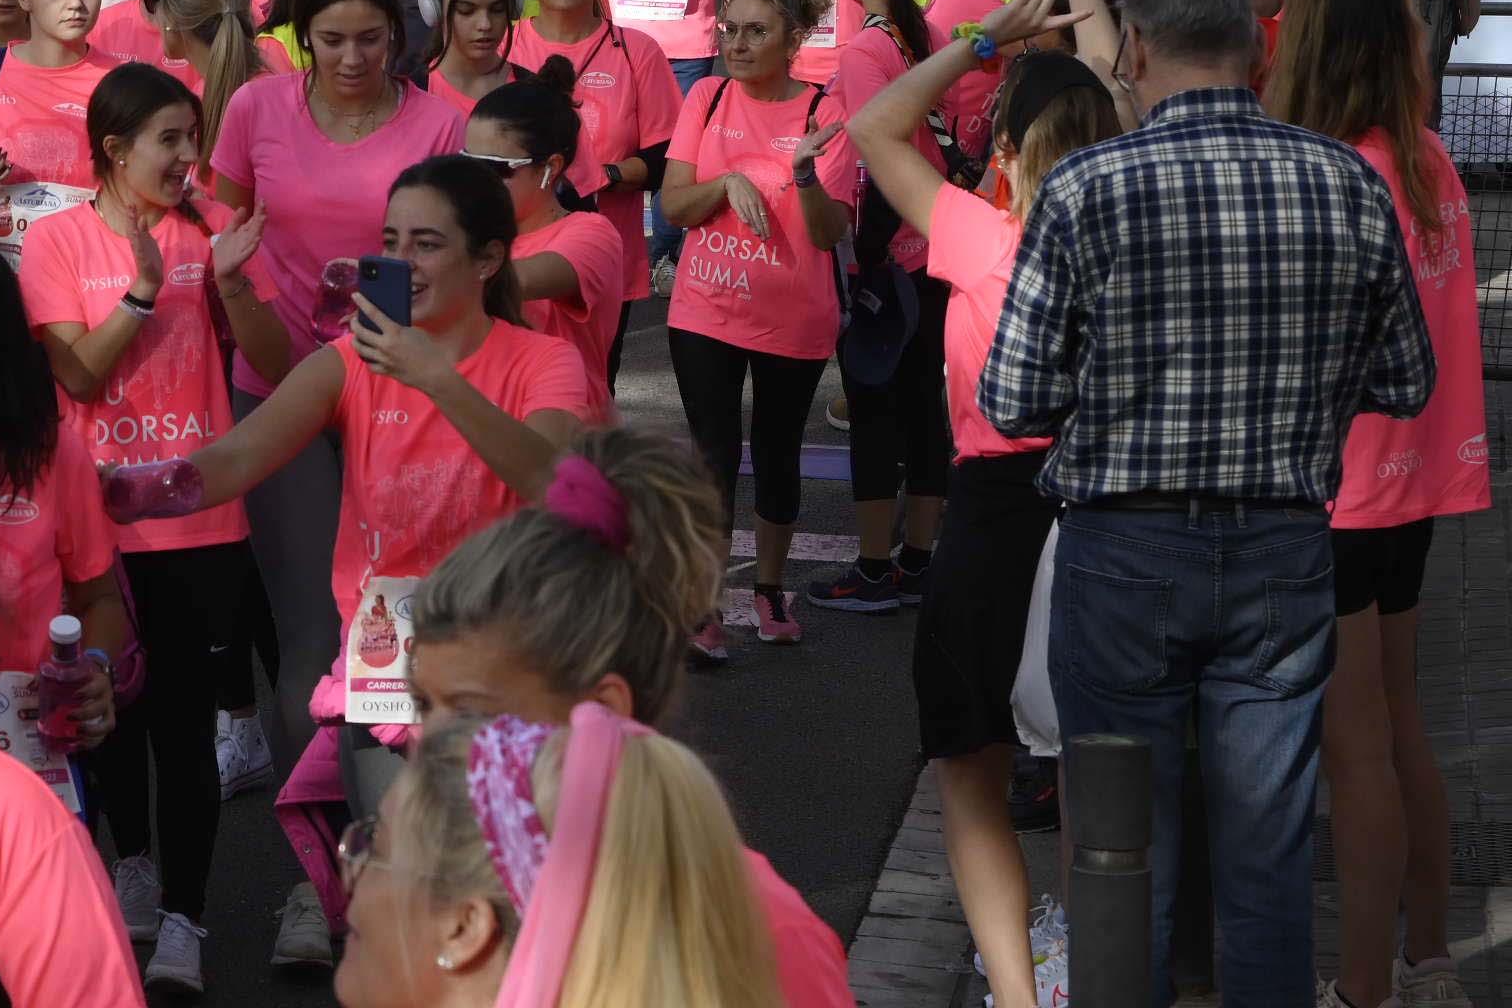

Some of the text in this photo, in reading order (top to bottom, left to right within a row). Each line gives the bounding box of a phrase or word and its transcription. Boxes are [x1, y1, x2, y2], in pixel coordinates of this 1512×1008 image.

[689, 255, 751, 292] SUMA
[105, 376, 125, 406] U
[95, 411, 216, 445] DORSAL
[361, 699, 412, 713] OYSHO
